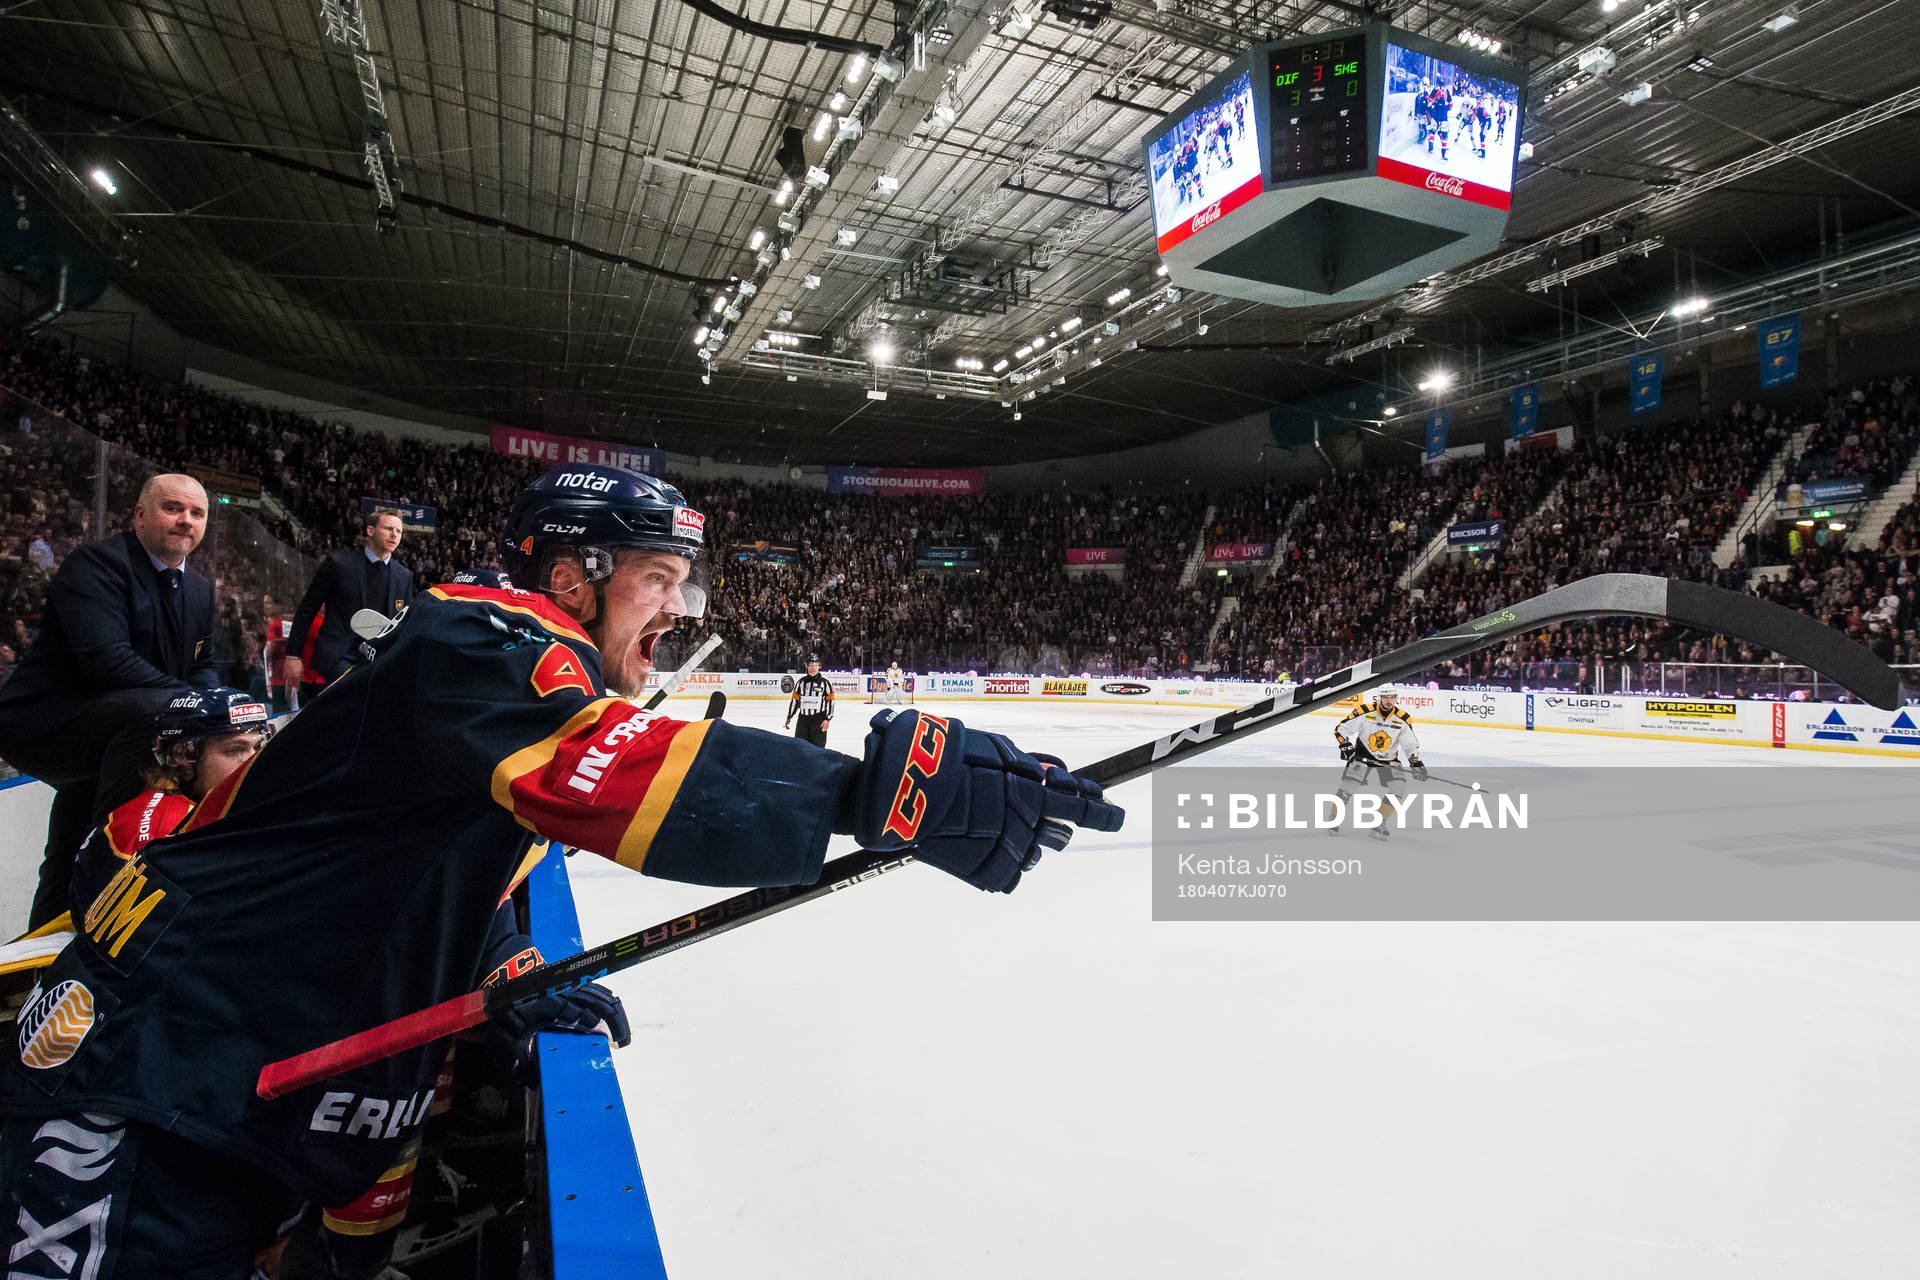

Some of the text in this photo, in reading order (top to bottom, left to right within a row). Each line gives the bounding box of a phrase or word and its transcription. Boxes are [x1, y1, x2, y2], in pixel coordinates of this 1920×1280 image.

[1276, 61, 1358, 86] DIF 3 SKE
[1290, 90, 1300, 106] 3
[1767, 329, 1792, 345] 27
[1638, 363, 1656, 376] 12
[508, 436, 650, 473] LIVE IS LIFE!
[554, 471, 619, 494] notar
[842, 476, 970, 489] STOCKHOLMLIVE.COM
[542, 523, 587, 535] CCM
[1450, 528, 1487, 539] ERICSSON
[1086, 552, 1106, 561] LIVE
[1243, 547, 1264, 557] LIVE
[984, 681, 1030, 693] Prioritet
[1043, 682, 1088, 691] BLÅKLÄDER
[170, 696, 203, 708] notar
[1648, 702, 1734, 713] HYRPOOLEN
[1450, 698, 1495, 719] Fabege
[1806, 724, 1866, 733] ERLANDSSON
